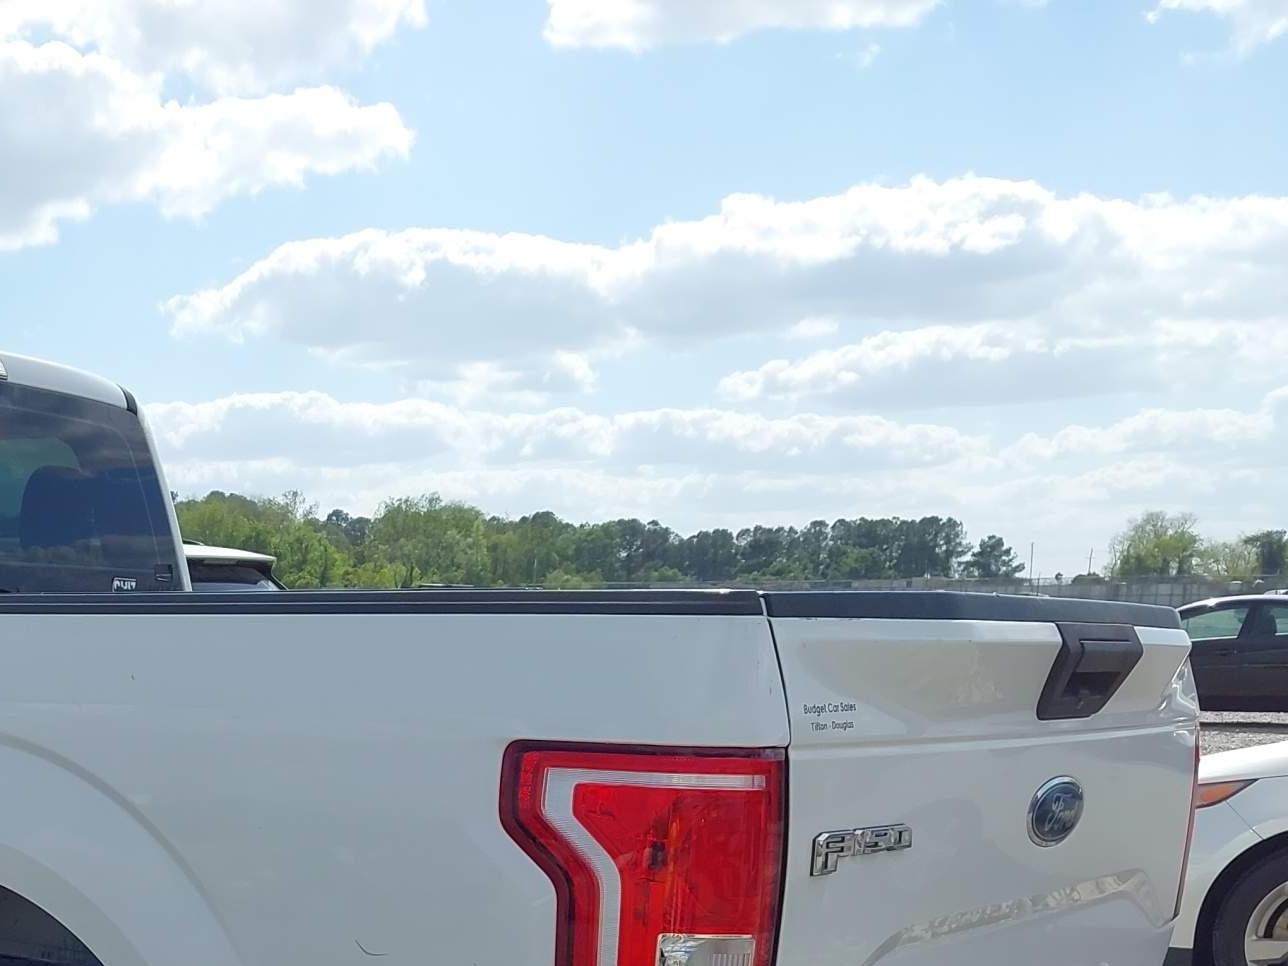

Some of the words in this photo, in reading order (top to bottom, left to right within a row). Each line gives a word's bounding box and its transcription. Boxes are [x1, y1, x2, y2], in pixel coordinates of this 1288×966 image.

[803, 703, 827, 717] Budget
[827, 702, 839, 713] Car
[839, 701, 857, 713] Sales
[831, 720, 855, 731] Douglas
